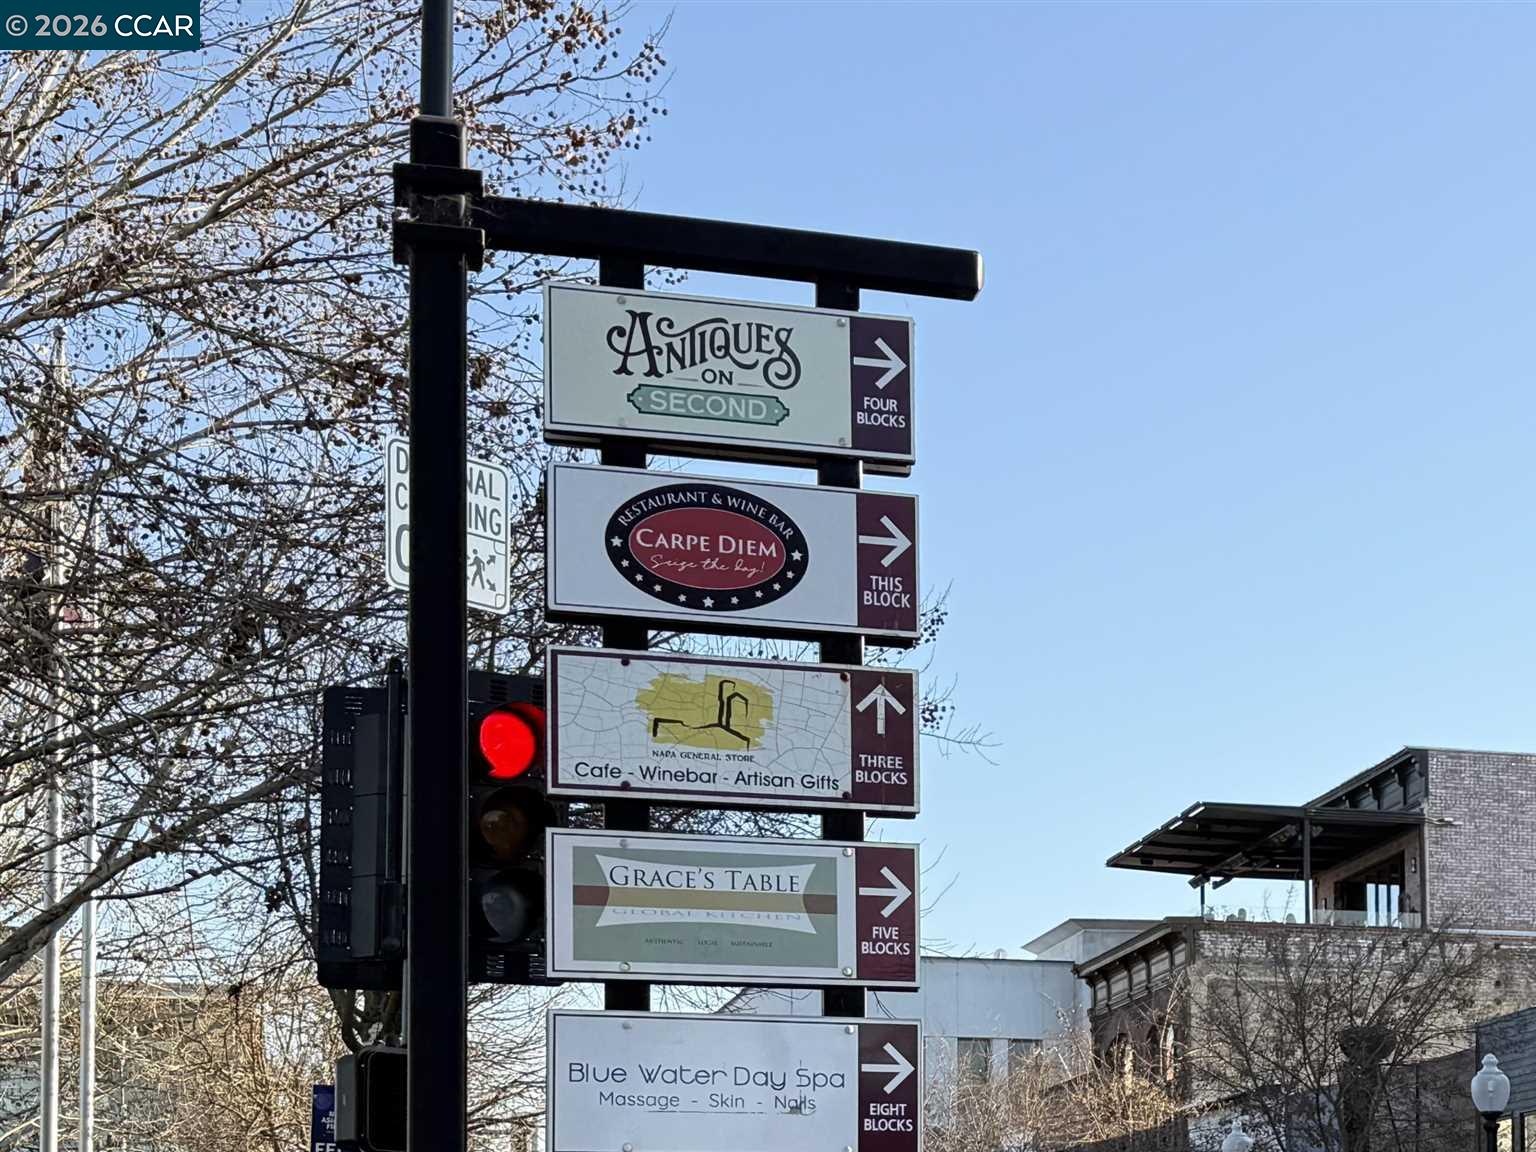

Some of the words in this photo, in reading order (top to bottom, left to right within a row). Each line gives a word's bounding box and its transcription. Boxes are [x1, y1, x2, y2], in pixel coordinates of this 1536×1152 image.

[606, 310, 801, 390] ANTIQUES
[701, 368, 734, 385] ON
[650, 391, 767, 420] SECOND
[863, 397, 898, 412] FOUR
[856, 412, 906, 428] BLOCKS
[617, 491, 708, 527] RESTAURANT
[711, 493, 723, 505] &
[727, 495, 768, 519] WINE
[768, 513, 794, 540] BAR
[636, 528, 710, 552] CARPE
[719, 535, 777, 557] DIEM
[700, 557, 730, 571] the
[870, 575, 903, 591] THIS
[863, 592, 911, 608] BLOCK
[652, 750, 677, 759] NAPA
[680, 751, 722, 762] GENERAL
[725, 754, 755, 763] STORE
[859, 754, 903, 769] THREE
[574, 762, 622, 780] Cafe
[639, 765, 718, 785] Winebar
[734, 768, 795, 788] Artisan
[800, 772, 840, 791] Gifts
[855, 770, 908, 785] BLOCKS
[608, 865, 715, 890] GRACE'S
[724, 869, 801, 893] TABLE
[872, 926, 899, 939] FIVE
[861, 941, 911, 956] BLOCKS
[568, 1062, 627, 1084] Blue
[638, 1063, 728, 1085] Water
[734, 1066, 787, 1091] Day
[795, 1068, 845, 1093] Spa
[599, 1091, 680, 1110] Massage
[709, 1093, 745, 1109] Skin
[774, 1095, 817, 1111] Nails
[869, 1103, 907, 1117] EIGHT
[864, 1118, 913, 1132] BLOCKS
